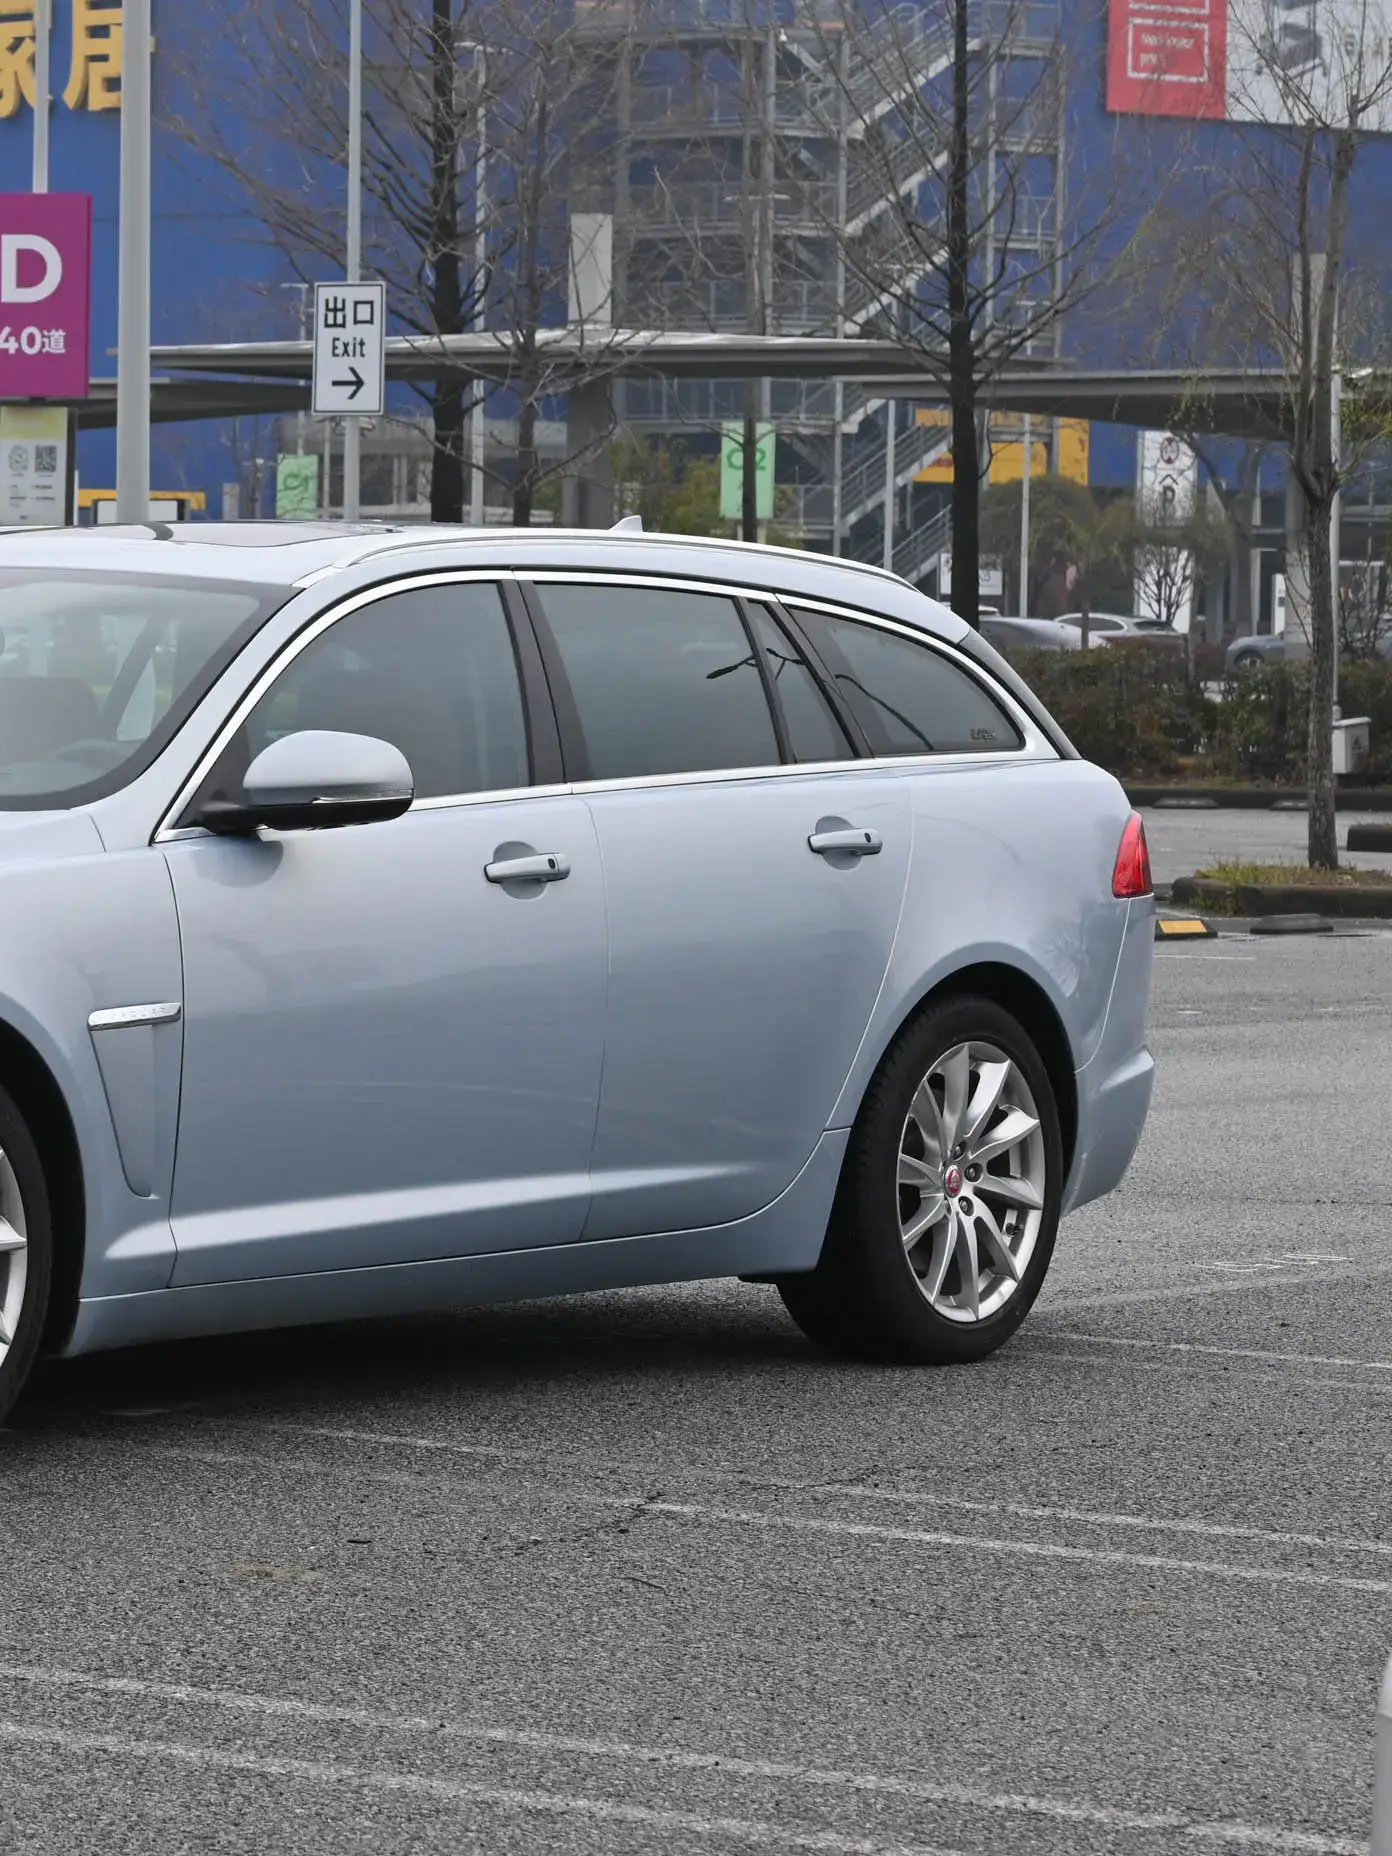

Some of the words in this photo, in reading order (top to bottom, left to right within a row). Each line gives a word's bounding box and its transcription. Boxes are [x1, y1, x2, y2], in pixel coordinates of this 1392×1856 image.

[1, 234, 62, 303] D
[324, 296, 374, 329] 出口
[332, 337, 365, 358] Exit
